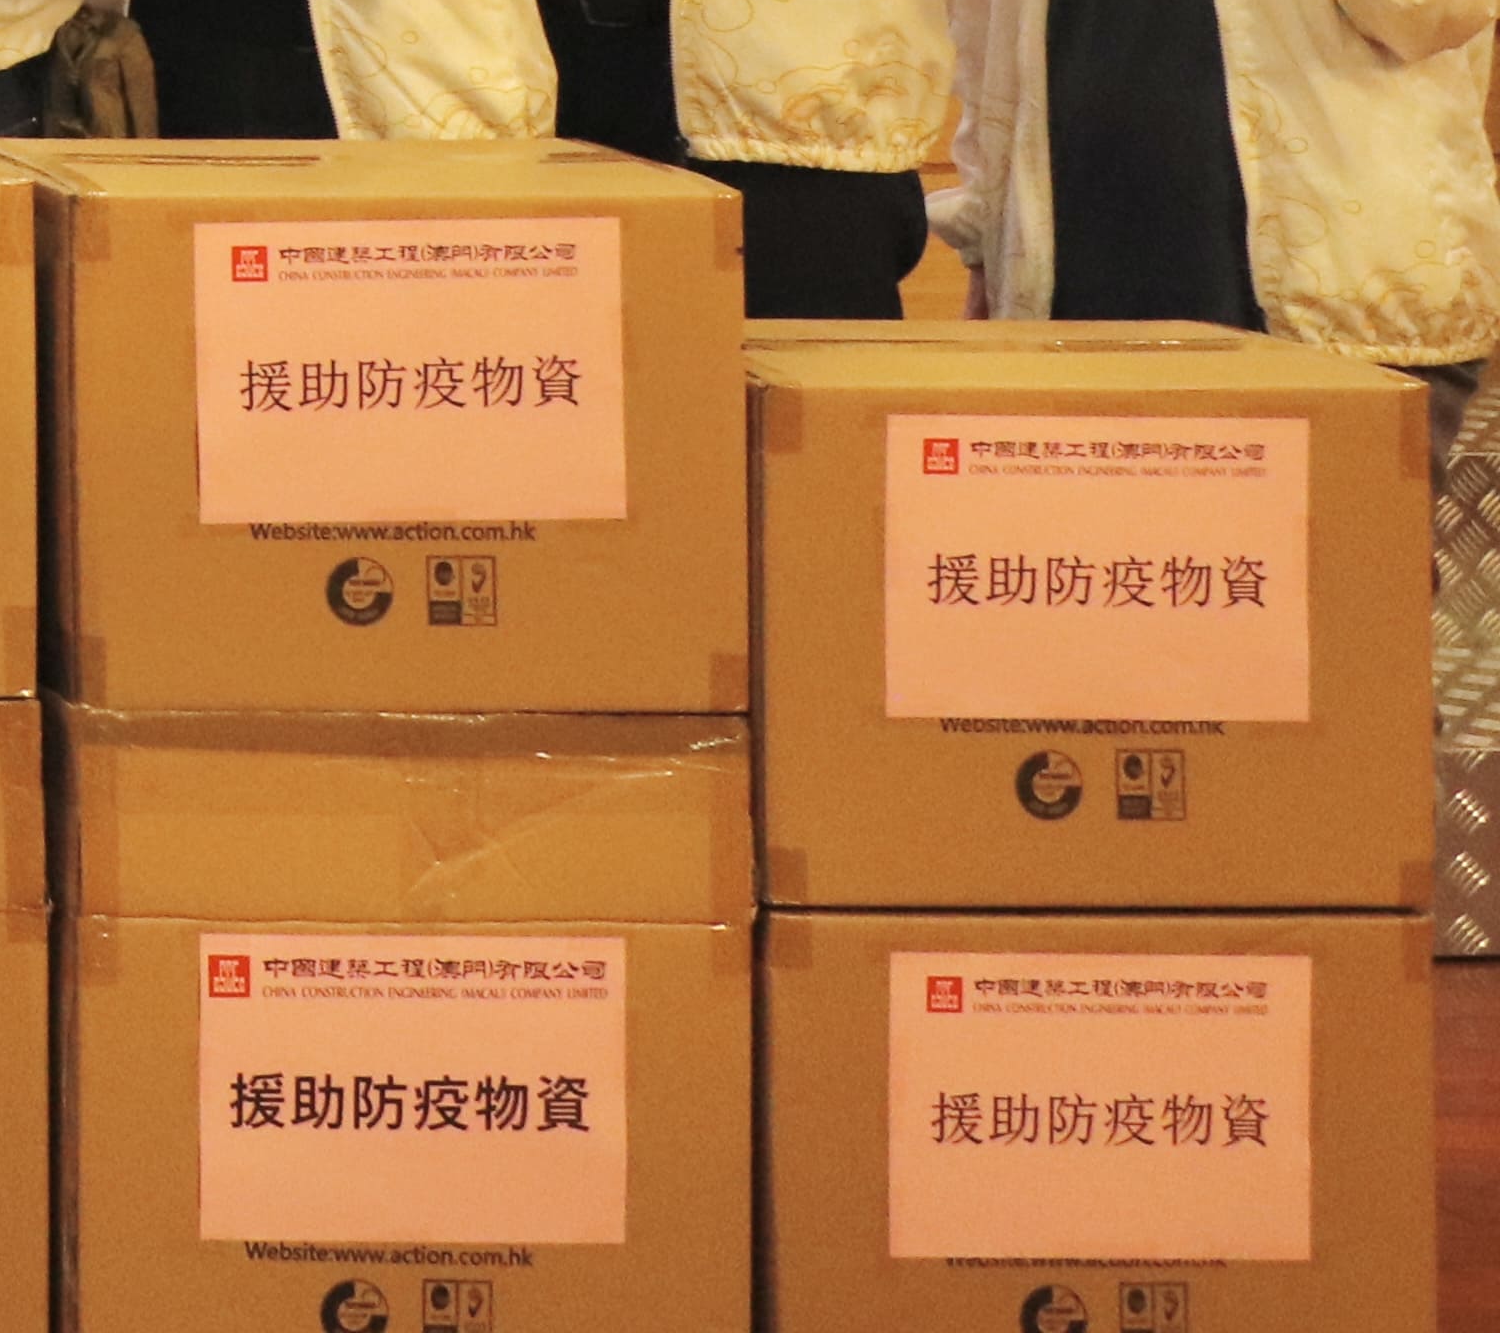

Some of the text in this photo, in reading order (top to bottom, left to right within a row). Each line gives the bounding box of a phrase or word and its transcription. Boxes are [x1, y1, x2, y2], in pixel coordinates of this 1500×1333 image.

[240, 354, 581, 412] 援助防疫物資
[927, 553, 1267, 608] 援助防疫物資
[229, 1072, 590, 1133] 援助防疫物資
[931, 1091, 1269, 1147] 援助防疫物資
[244, 1241, 534, 1267] Website:www.action.com.hk
